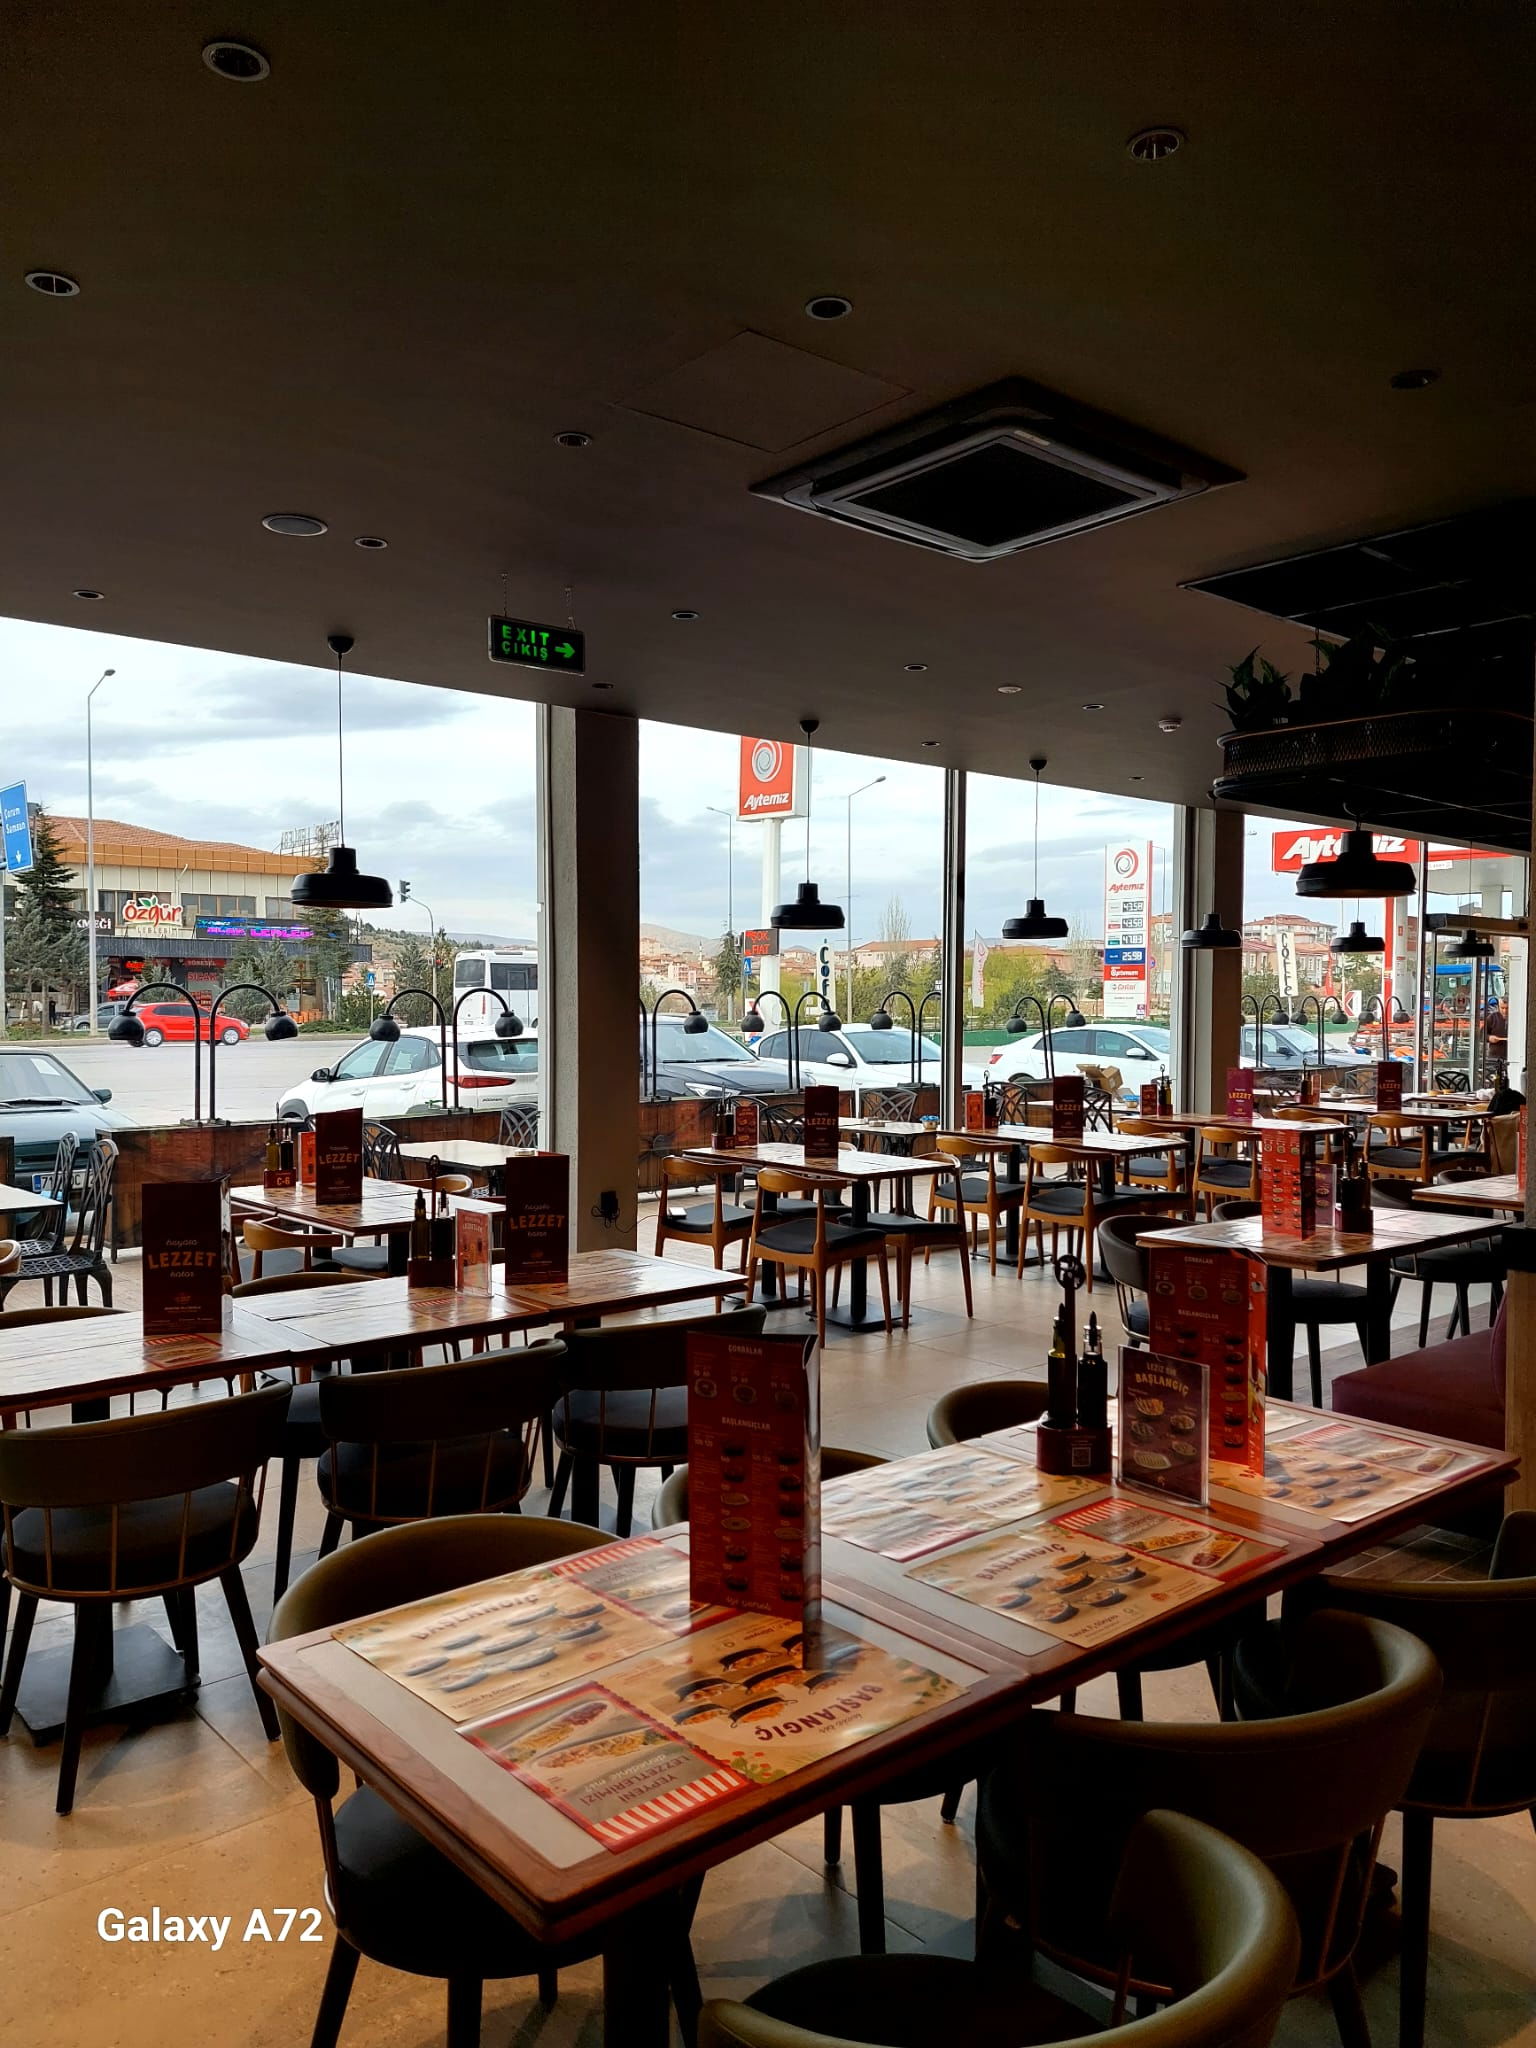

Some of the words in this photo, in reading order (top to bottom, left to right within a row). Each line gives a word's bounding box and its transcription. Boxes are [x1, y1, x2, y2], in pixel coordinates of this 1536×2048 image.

[502, 624, 550, 646] EXIT
[502, 640, 548, 661] ÇIKIŞ
[744, 793, 789, 811] Aytemiz
[1281, 834, 1407, 865] Aytiz
[1108, 883, 1145, 893] Aytemiz
[124, 901, 182, 928] Özgür
[1228, 1091, 1253, 1100] LEZZET
[319, 1153, 360, 1165] LEZZET
[508, 1214, 565, 1230] LEZZET
[147, 1251, 217, 1270] LEZZET
[1135, 1372, 1190, 1397] BAŞLANGIÇ
[975, 1542, 1068, 1581] BAŞLANGIÇ
[755, 1683, 884, 1743] BAŞLANGIÇ
